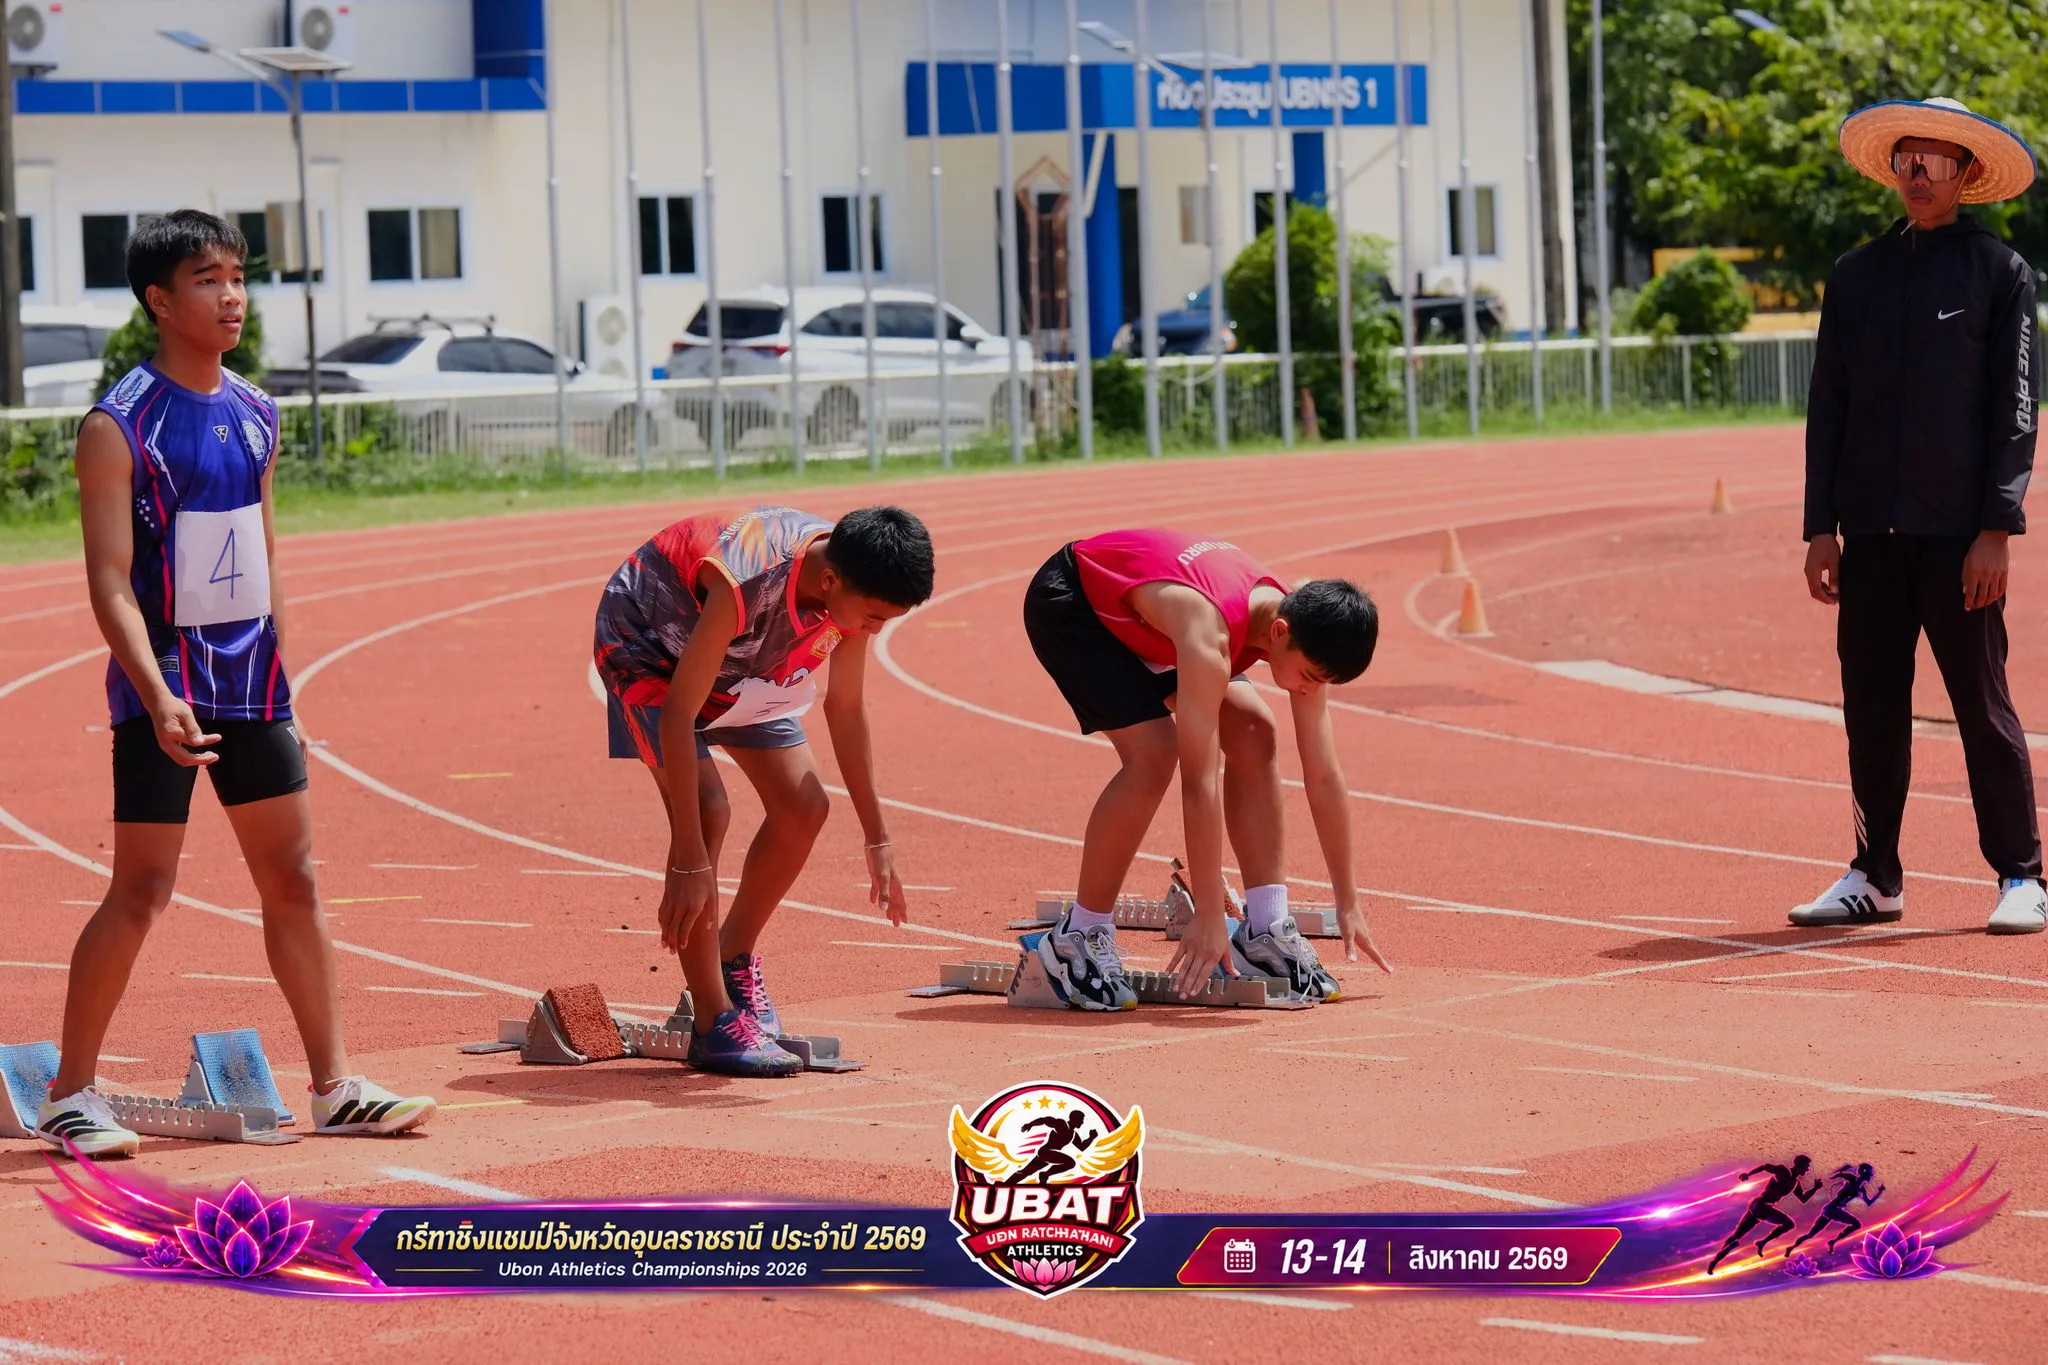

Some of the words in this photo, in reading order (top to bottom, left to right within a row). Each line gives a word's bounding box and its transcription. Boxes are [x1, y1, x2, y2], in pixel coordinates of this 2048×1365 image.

[1364, 77, 1378, 109] 1
[2018, 312, 2031, 376] NIKE
[2016, 376, 2032, 433] PRO
[209, 528, 243, 599] 4
